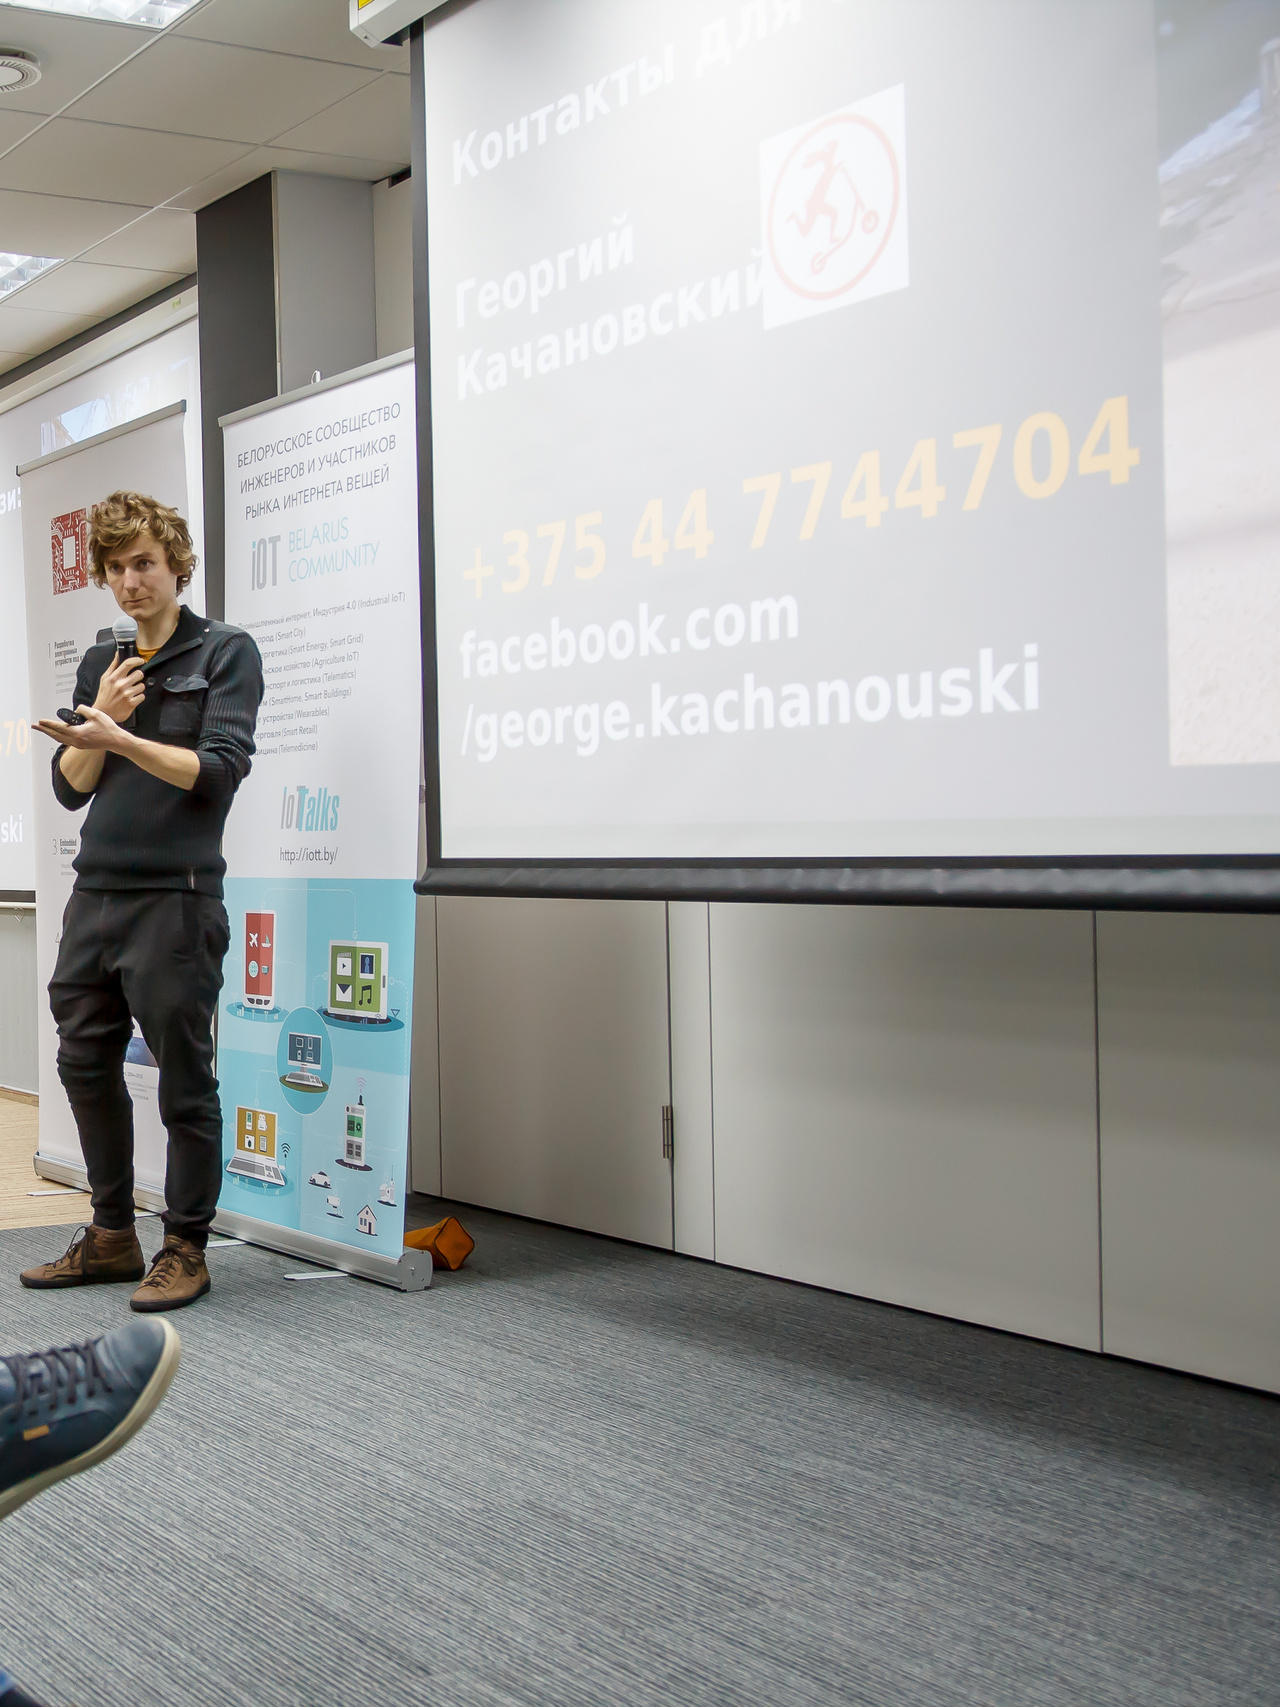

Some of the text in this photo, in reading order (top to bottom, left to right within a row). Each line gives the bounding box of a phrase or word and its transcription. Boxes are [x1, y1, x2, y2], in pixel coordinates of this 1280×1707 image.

[452, 0, 802, 186] Контакты для
[455, 213, 635, 328] Георгий
[456, 250, 768, 400] Качановский
[237, 402, 401, 468] БЕЛОРУССКОЕ СООБЩЕСТВО
[240, 434, 396, 494] ИНЖЕНЕРОВ И УЧАСТНИКОВ
[245, 462, 390, 520] РЫНКА ИНТЕРНЕТА ВЕЩЕЙ
[462, 395, 1140, 601] +375 44 7744704
[288, 516, 349, 553] BELARUS
[288, 540, 380, 582] COMMUNITY
[261, 648, 287, 661] ергетика
[460, 592, 800, 678] facebook.com
[262, 666, 282, 675] ьское
[265, 680, 286, 691] нспорт
[460, 643, 1040, 762] /george.kachanouski
[279, 846, 339, 865] http://iott.by/
